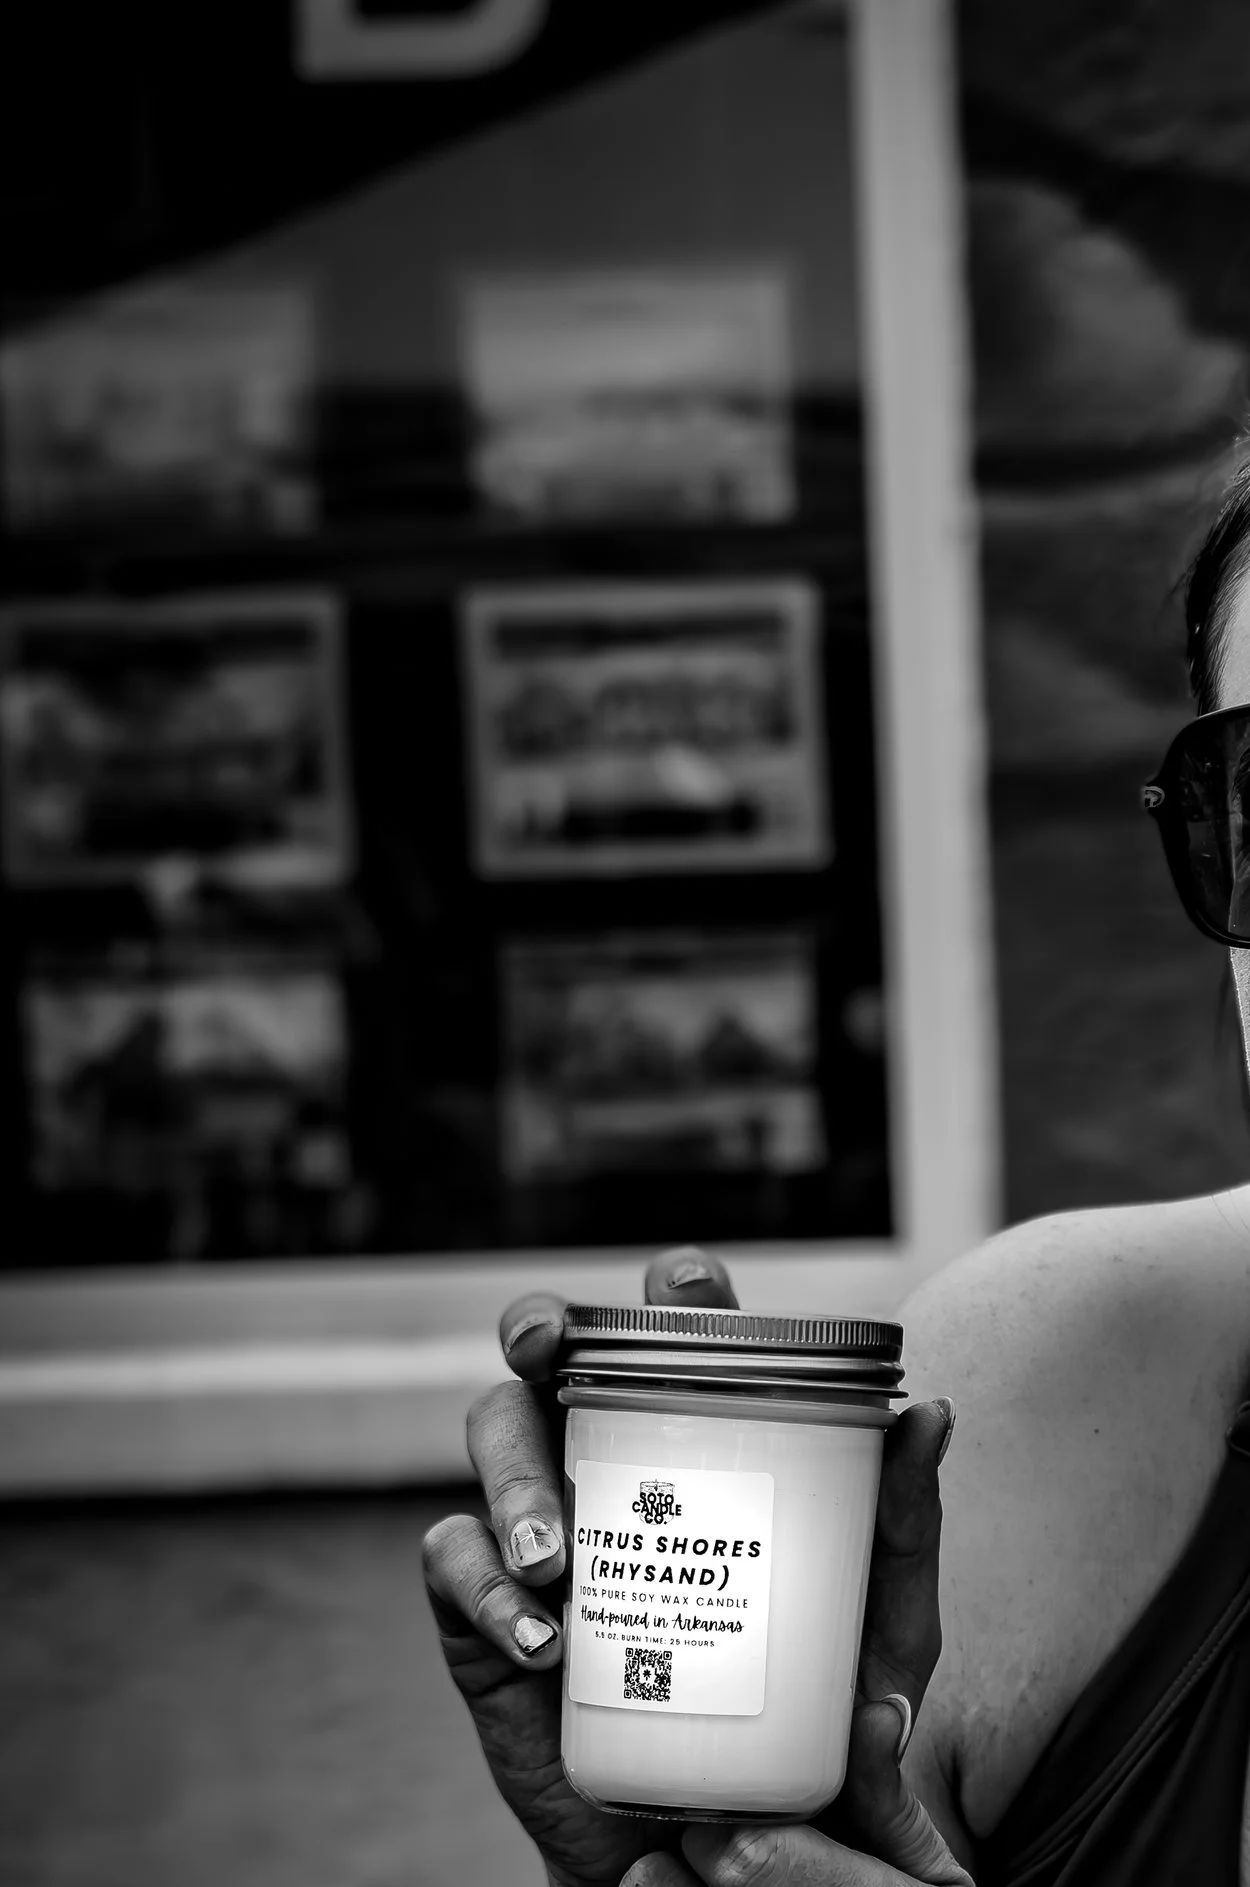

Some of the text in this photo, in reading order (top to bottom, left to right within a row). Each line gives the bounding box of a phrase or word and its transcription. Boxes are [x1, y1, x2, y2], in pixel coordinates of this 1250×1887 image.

[640, 1492, 675, 1504] SOTO
[632, 1501, 682, 1516] CANDLE
[645, 1511, 667, 1525] CO.
[578, 1528, 761, 1558] CITRUS SHORES
[591, 1555, 730, 1591] (RHYSAND)
[580, 1585, 748, 1608] 100% PURE SOY WAX CANDLE
[581, 1604, 744, 1633] Hand-poured in Arkansas
[595, 1631, 605, 1639] 5.5
[621, 1634, 641, 1642] BURN
[645, 1636, 666, 1644] TIME:
